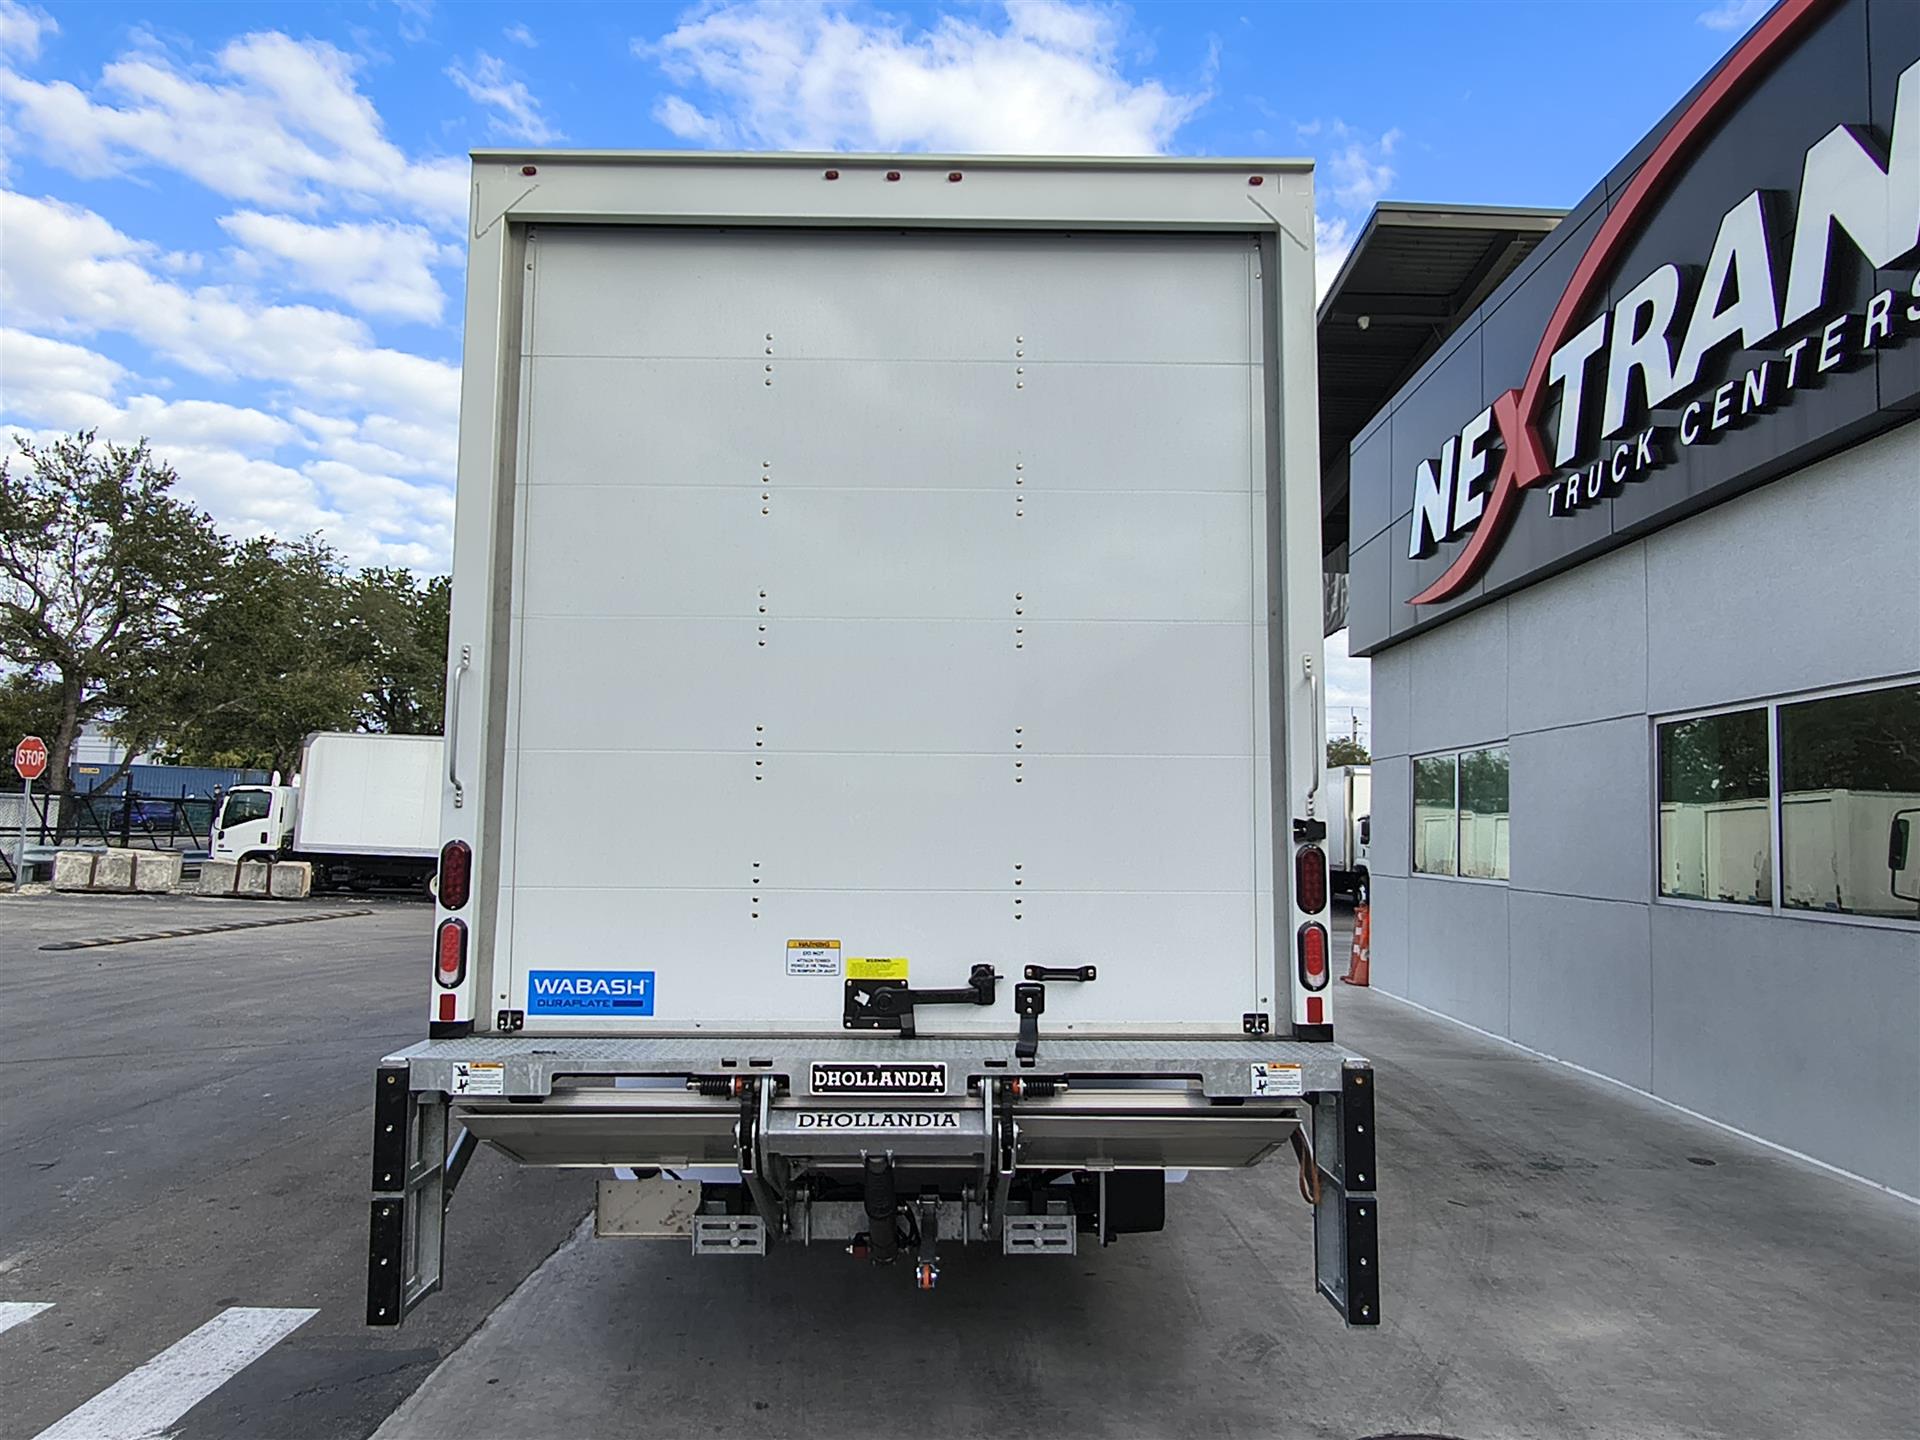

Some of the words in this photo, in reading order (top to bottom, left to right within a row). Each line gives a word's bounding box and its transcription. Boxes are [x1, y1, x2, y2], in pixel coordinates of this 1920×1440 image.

[1408, 57, 1920, 559] NEXTRAN
[1547, 425, 1654, 517] TRUCK
[18, 749, 45, 766] STOP
[534, 979, 645, 995] WABASH
[537, 999, 610, 1008] DURAPLATE
[814, 1071, 943, 1087] DHOLLANDIA
[798, 1113, 957, 1127] DHOLLANDIA
